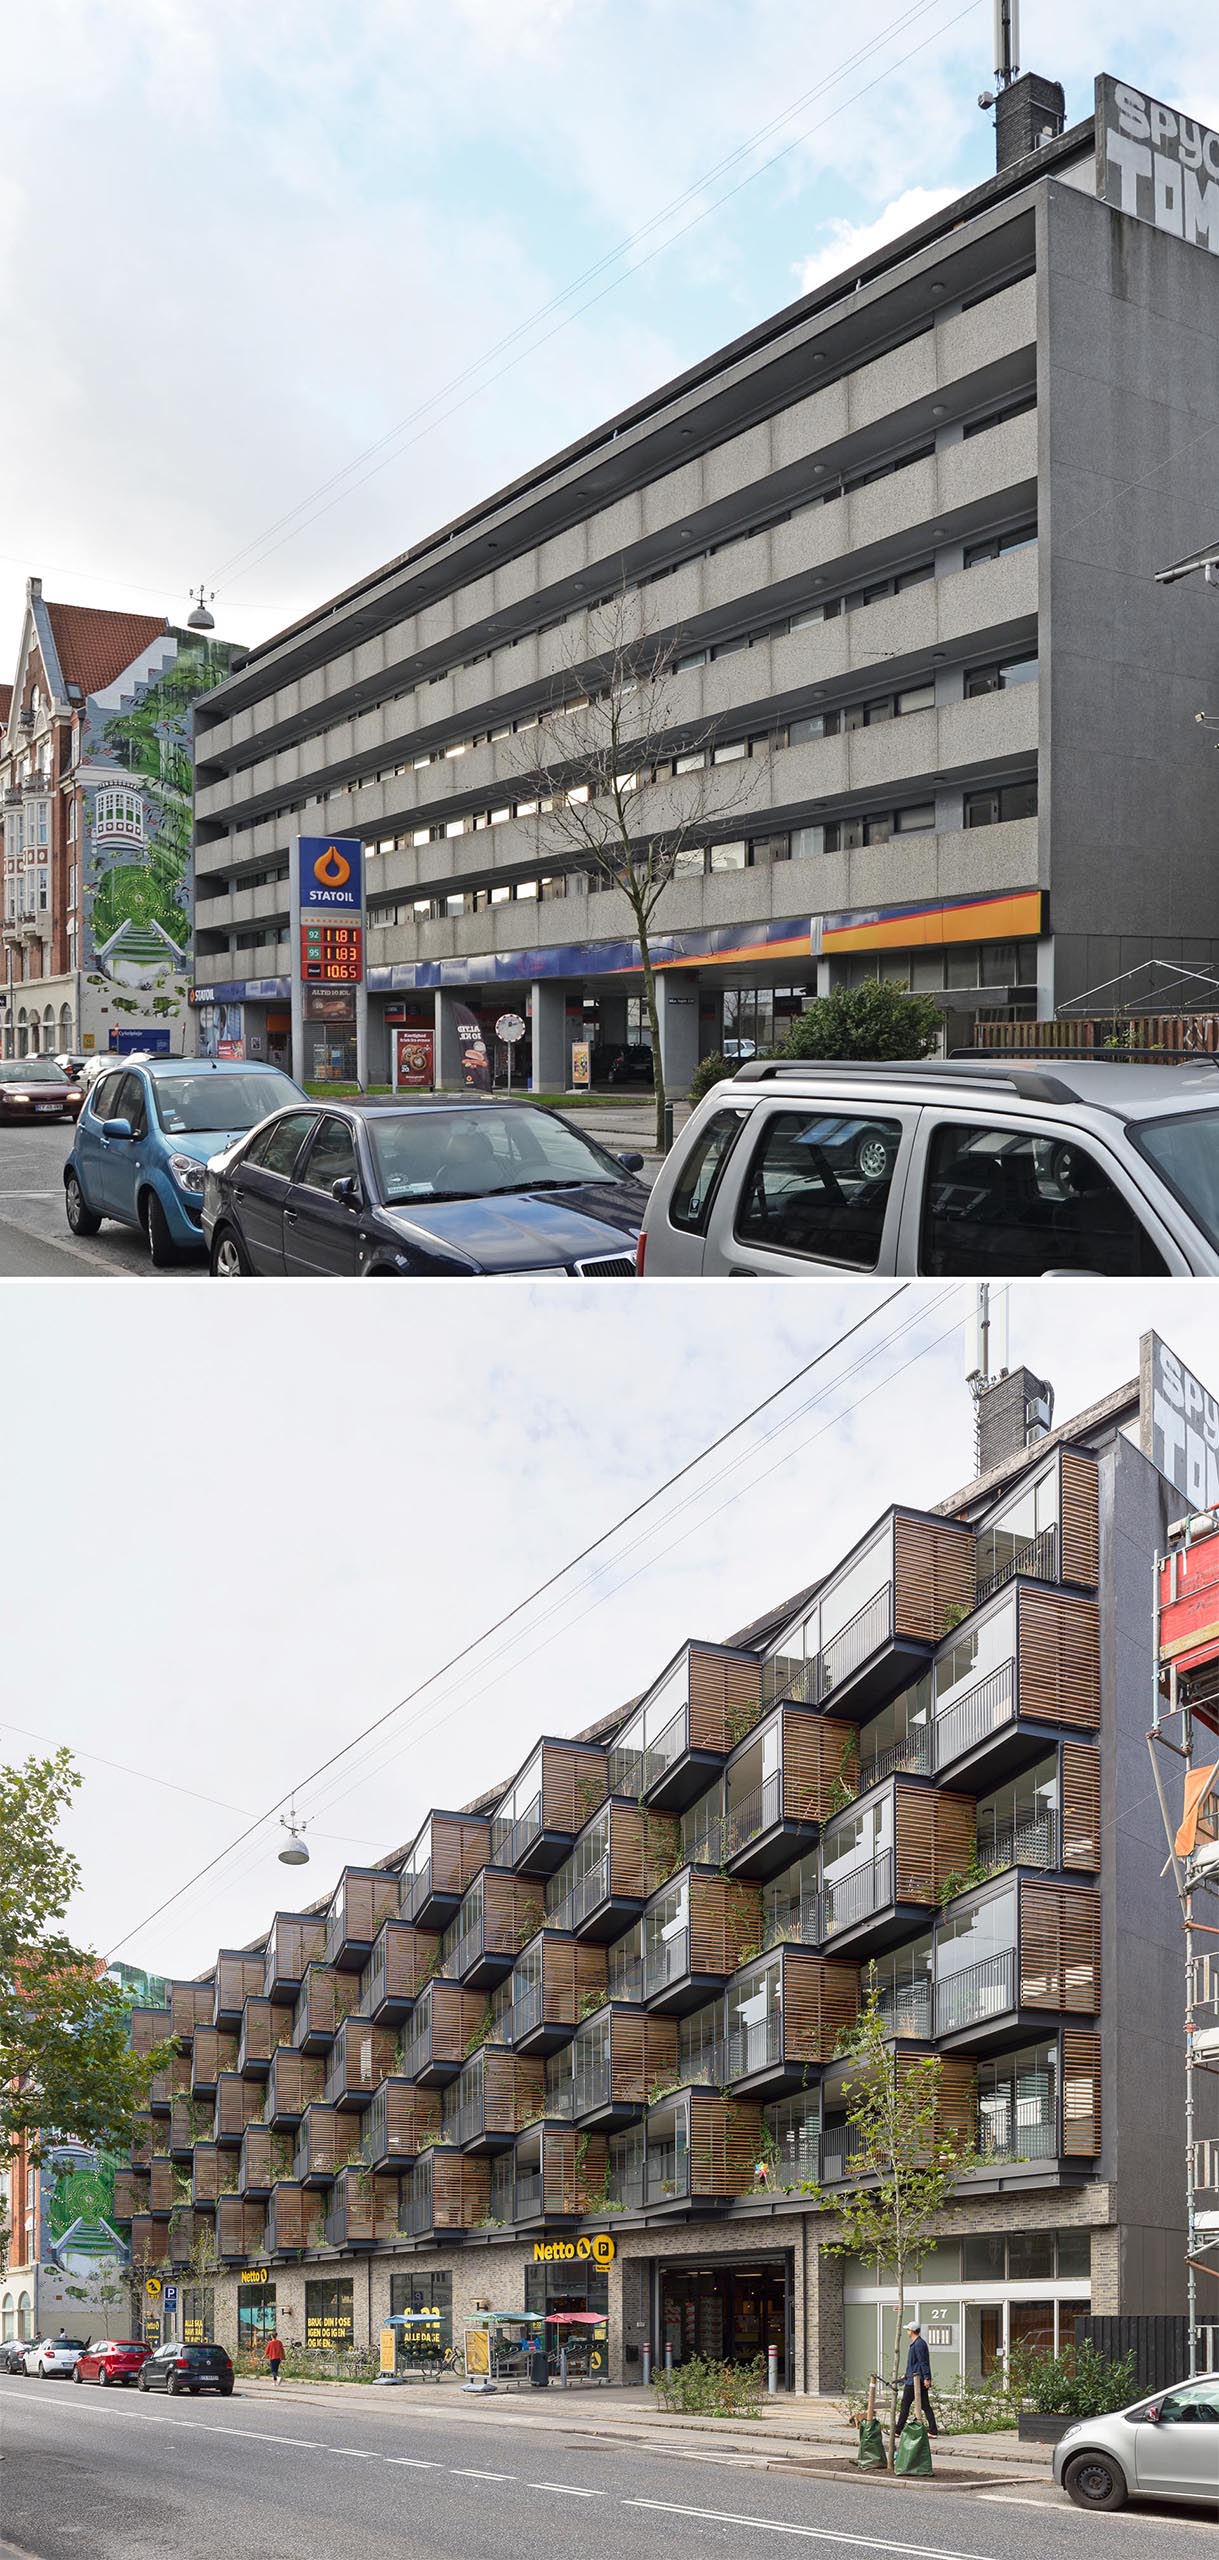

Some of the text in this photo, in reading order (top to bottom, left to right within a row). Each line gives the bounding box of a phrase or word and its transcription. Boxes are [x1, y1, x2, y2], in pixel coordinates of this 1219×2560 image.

[309, 890, 354, 902] STATOIL
[308, 929, 357, 942] 92 11.81
[308, 947, 357, 960] 95 11.83
[195, 988, 215, 1001] STATOIL
[534, 2242, 575, 2260] Netto
[600, 2244, 607, 2255] P
[241, 2271, 260, 2283] Netto
[167, 2288, 175, 2298] P
[931, 2309, 948, 2319] 27
[324, 2317, 334, 2327] DIN
[308, 2328, 345, 2337] IGEN OG IGEN
[308, 2338, 317, 2347] OG
